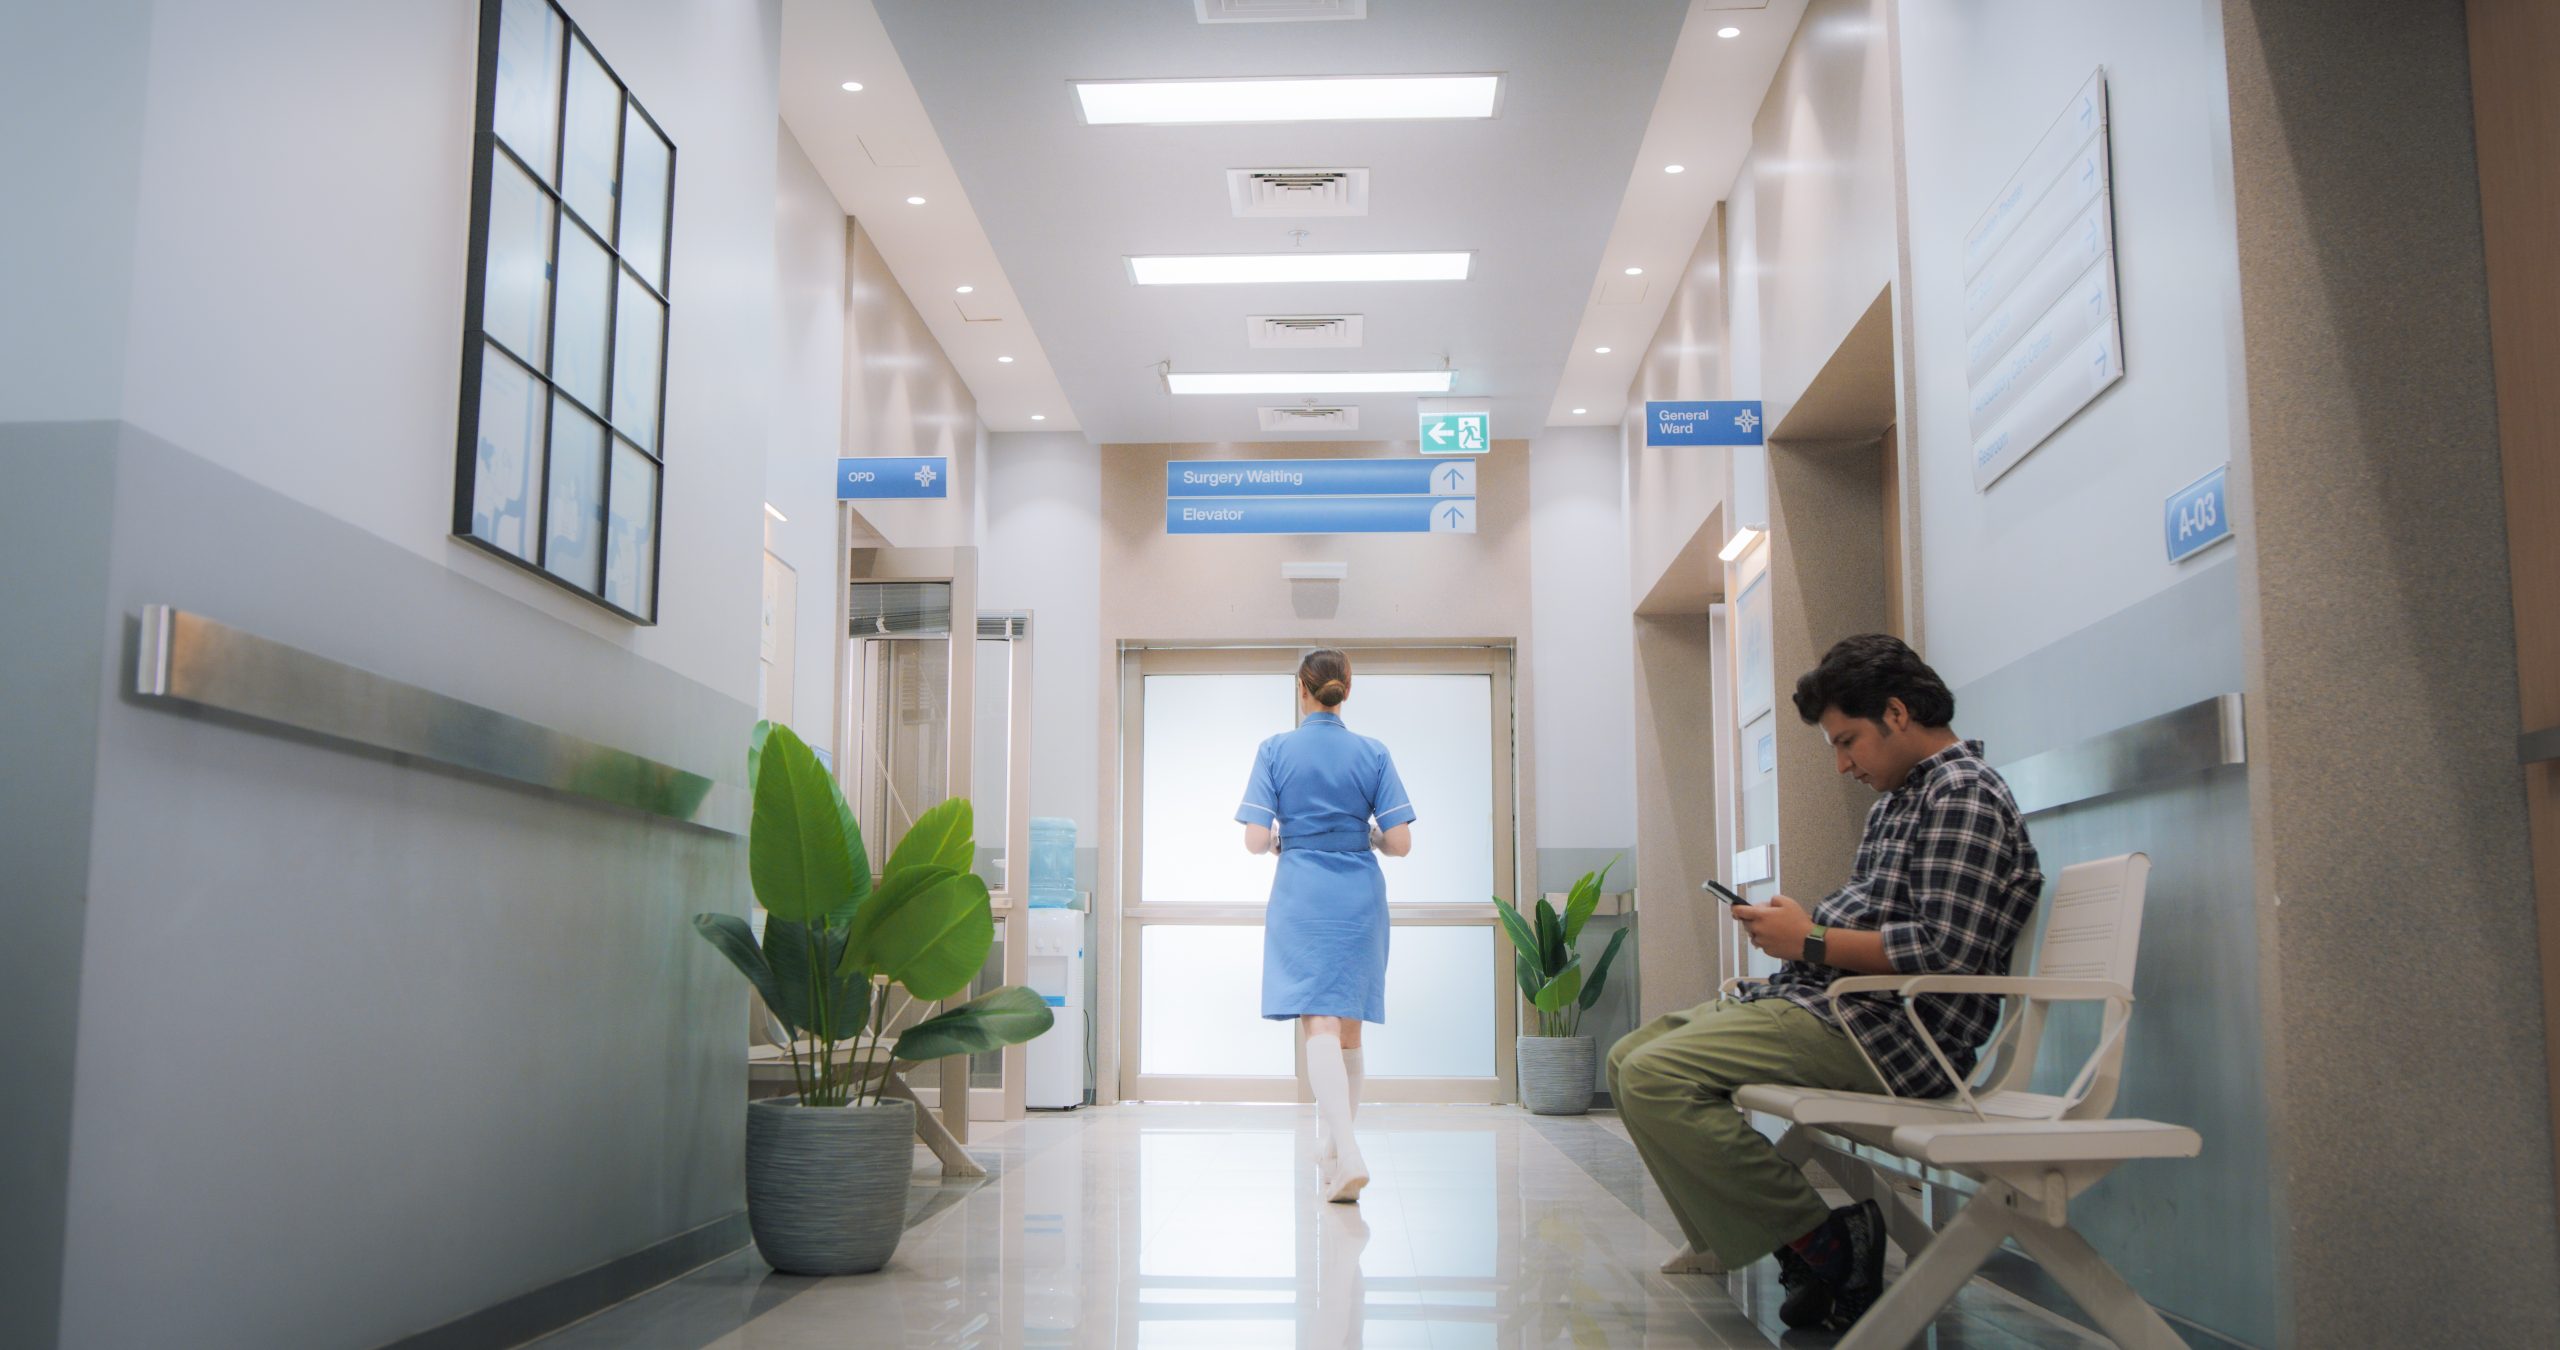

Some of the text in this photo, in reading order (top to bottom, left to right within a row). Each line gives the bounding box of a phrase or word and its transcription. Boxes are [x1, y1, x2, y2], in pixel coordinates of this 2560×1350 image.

[1659, 409, 1709, 421] General
[1659, 423, 1693, 434] Ward
[848, 471, 876, 482] OPD
[1183, 469, 1303, 487] Surgery Waiting
[1183, 507, 1244, 521] Elevator
[2179, 491, 2216, 541] A-03
